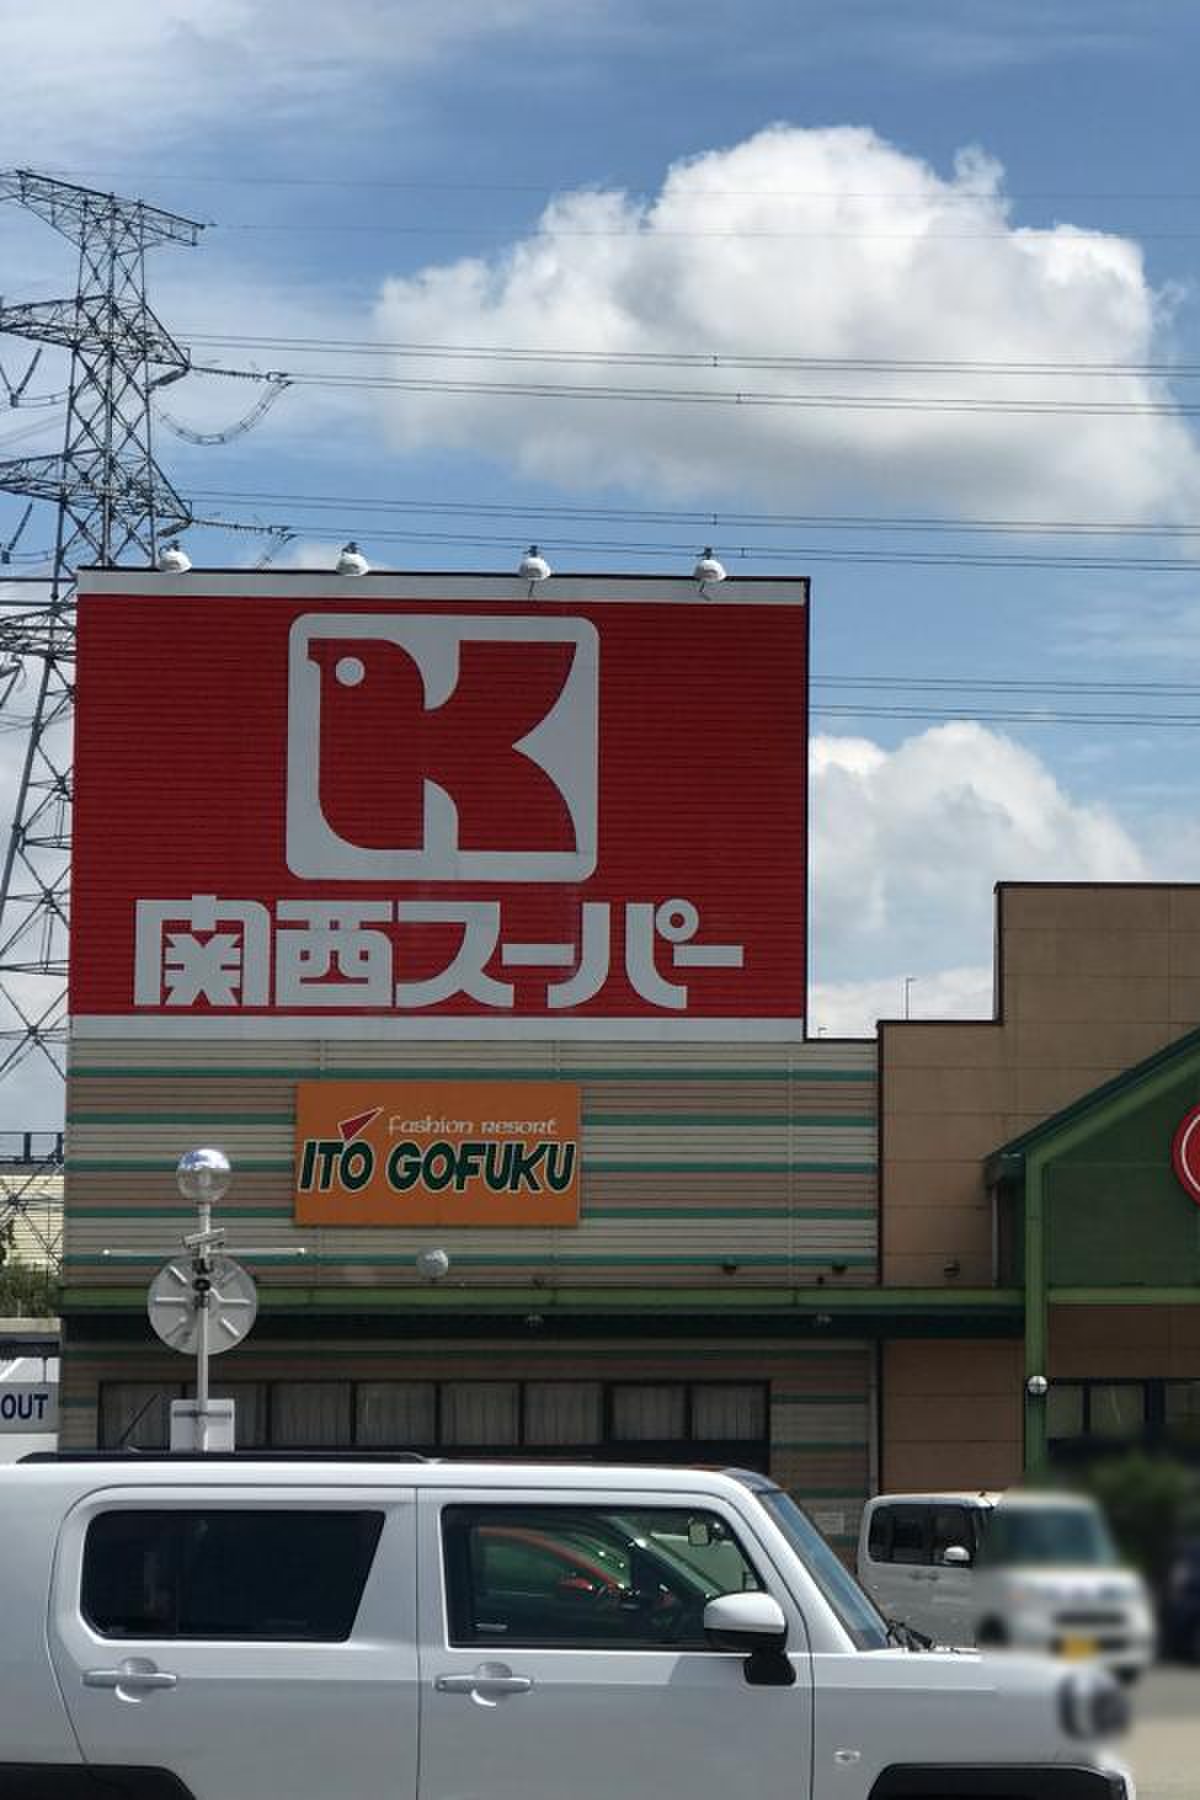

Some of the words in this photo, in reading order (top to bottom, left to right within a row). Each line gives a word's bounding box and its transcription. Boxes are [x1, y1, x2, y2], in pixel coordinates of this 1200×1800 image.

[133, 894, 744, 1010] 関西スーパー
[298, 1139, 375, 1192] ITO
[385, 1139, 577, 1194] GOFUKU
[1, 1393, 48, 1419] OUT
